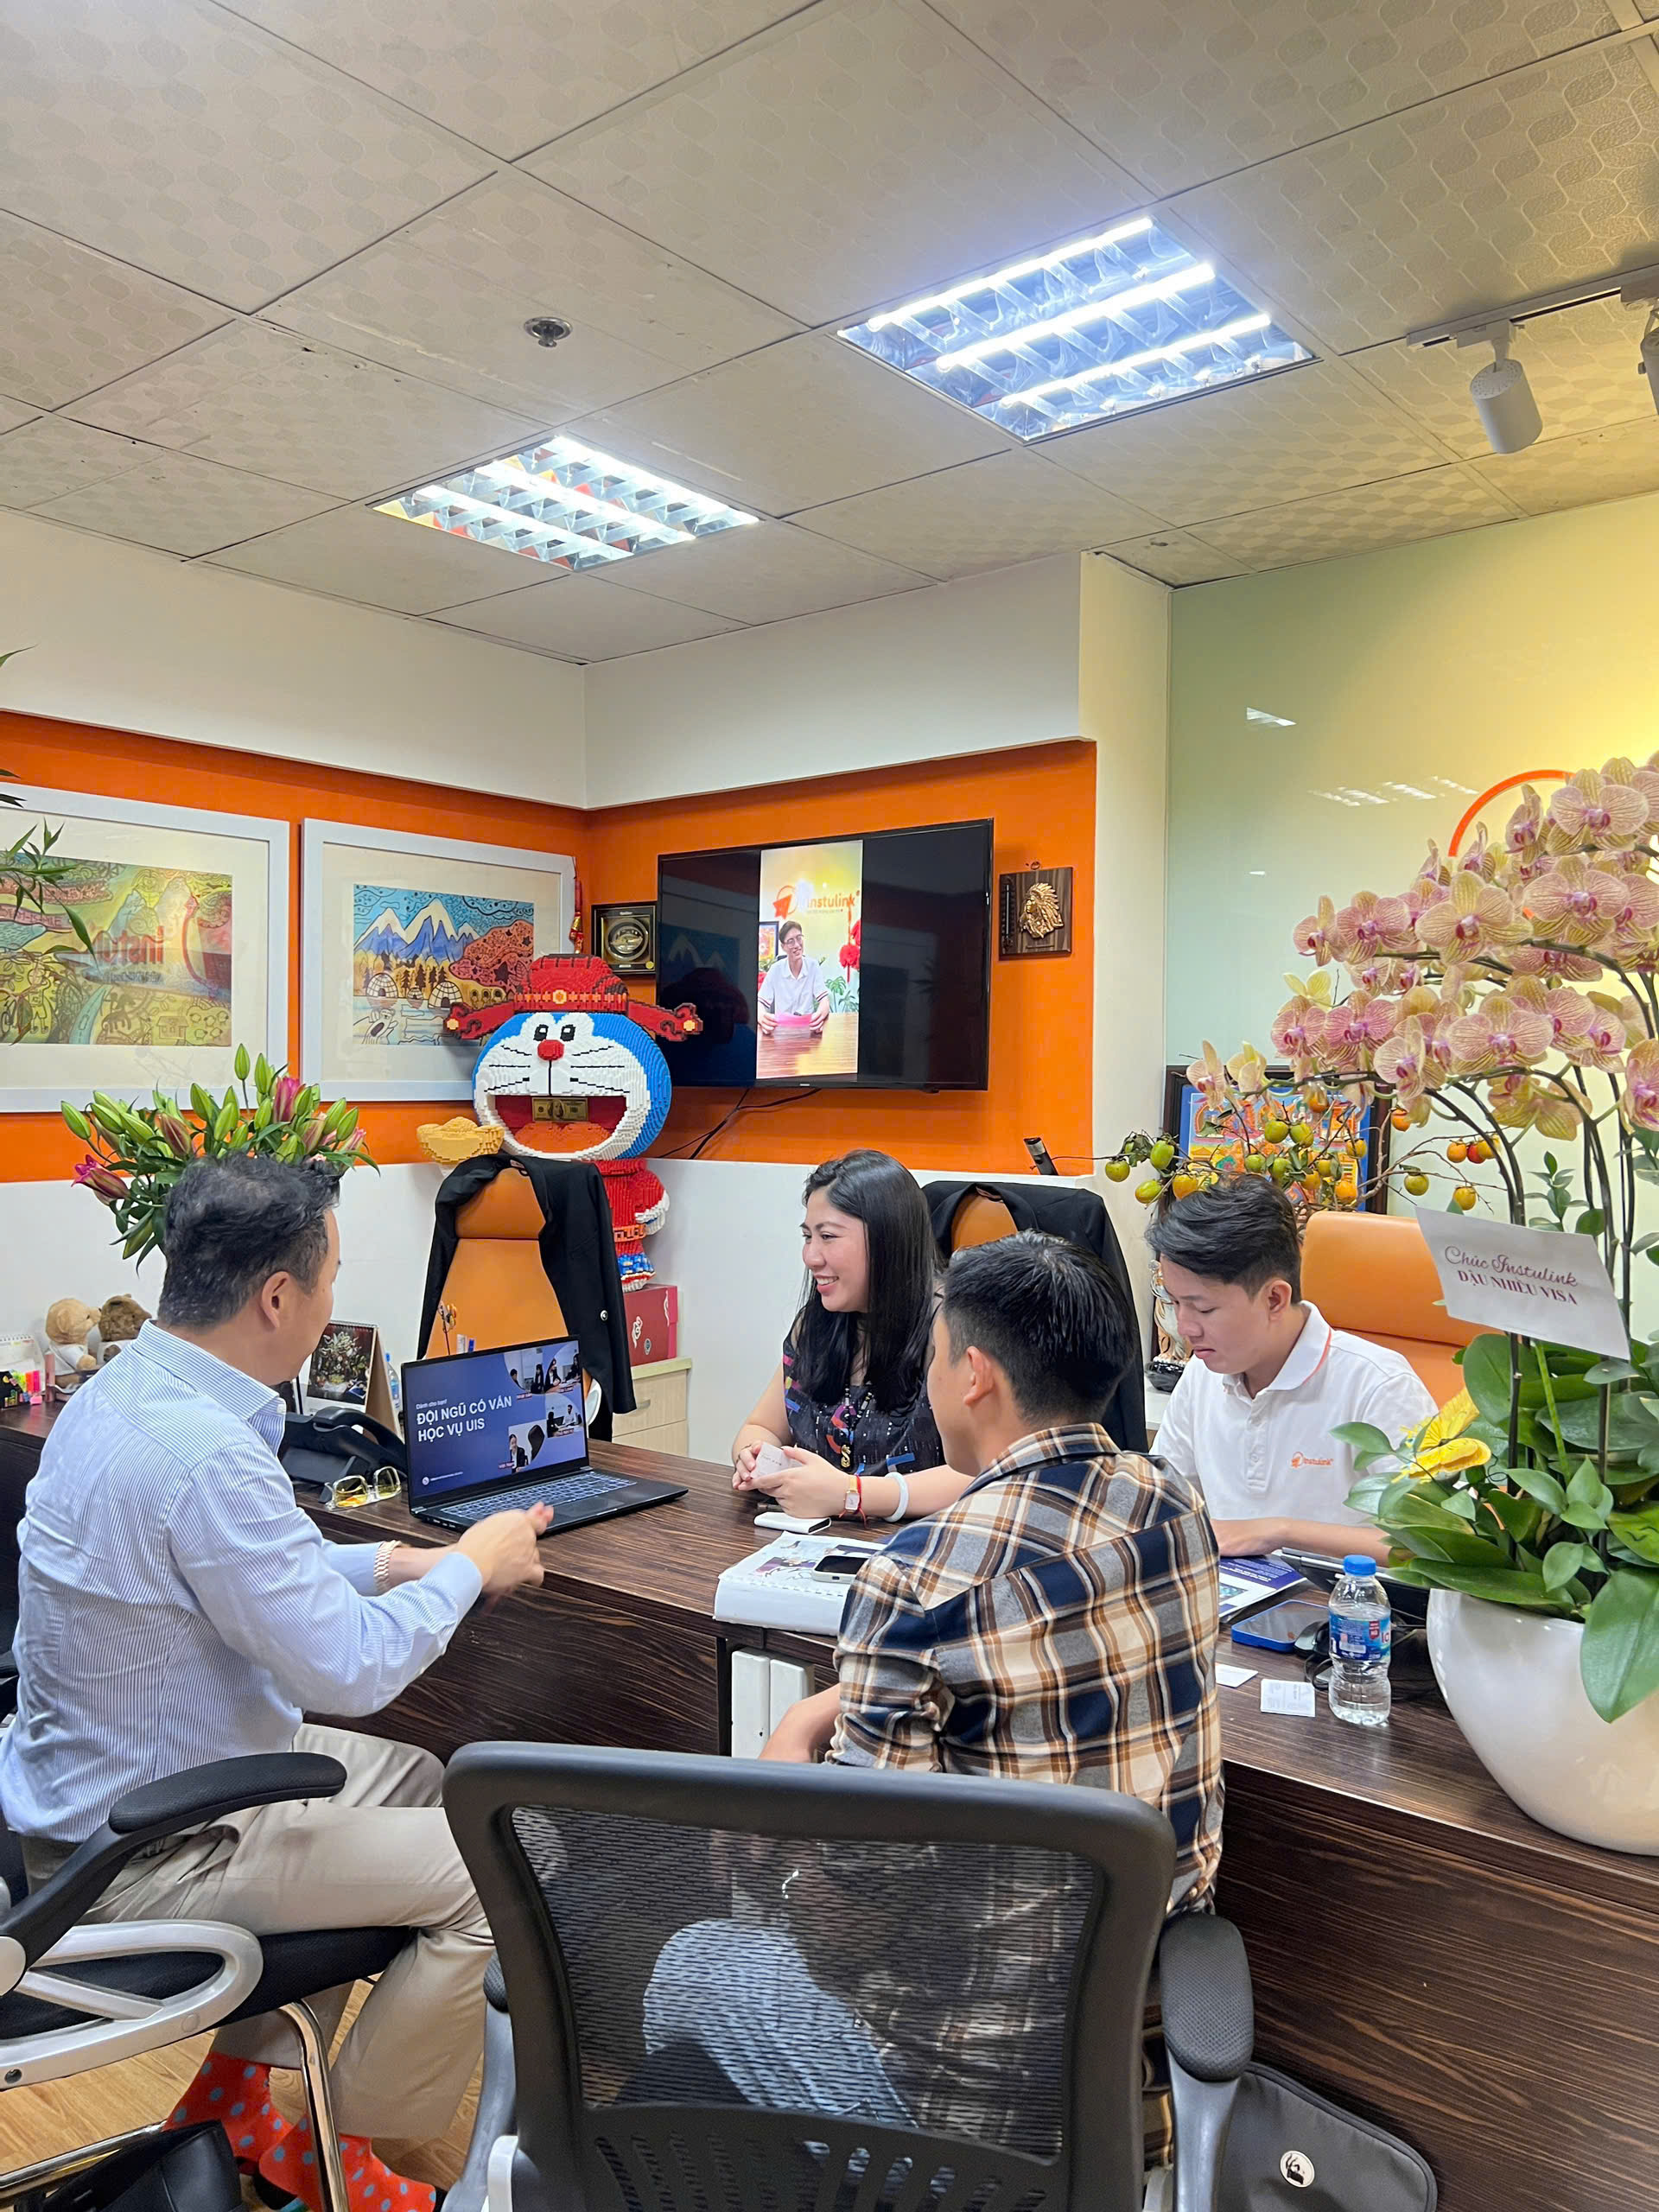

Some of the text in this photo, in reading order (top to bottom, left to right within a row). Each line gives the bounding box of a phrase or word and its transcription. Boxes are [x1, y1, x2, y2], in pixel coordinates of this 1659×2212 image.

[1445, 1245, 1578, 1287] Chúc Instulink
[1540, 1285, 1578, 1305] VISA
[416, 1409, 439, 1426] ĐỘI
[441, 1402, 467, 1421] NGŨ
[417, 1417, 485, 1443] HỌC VỤ UIS
